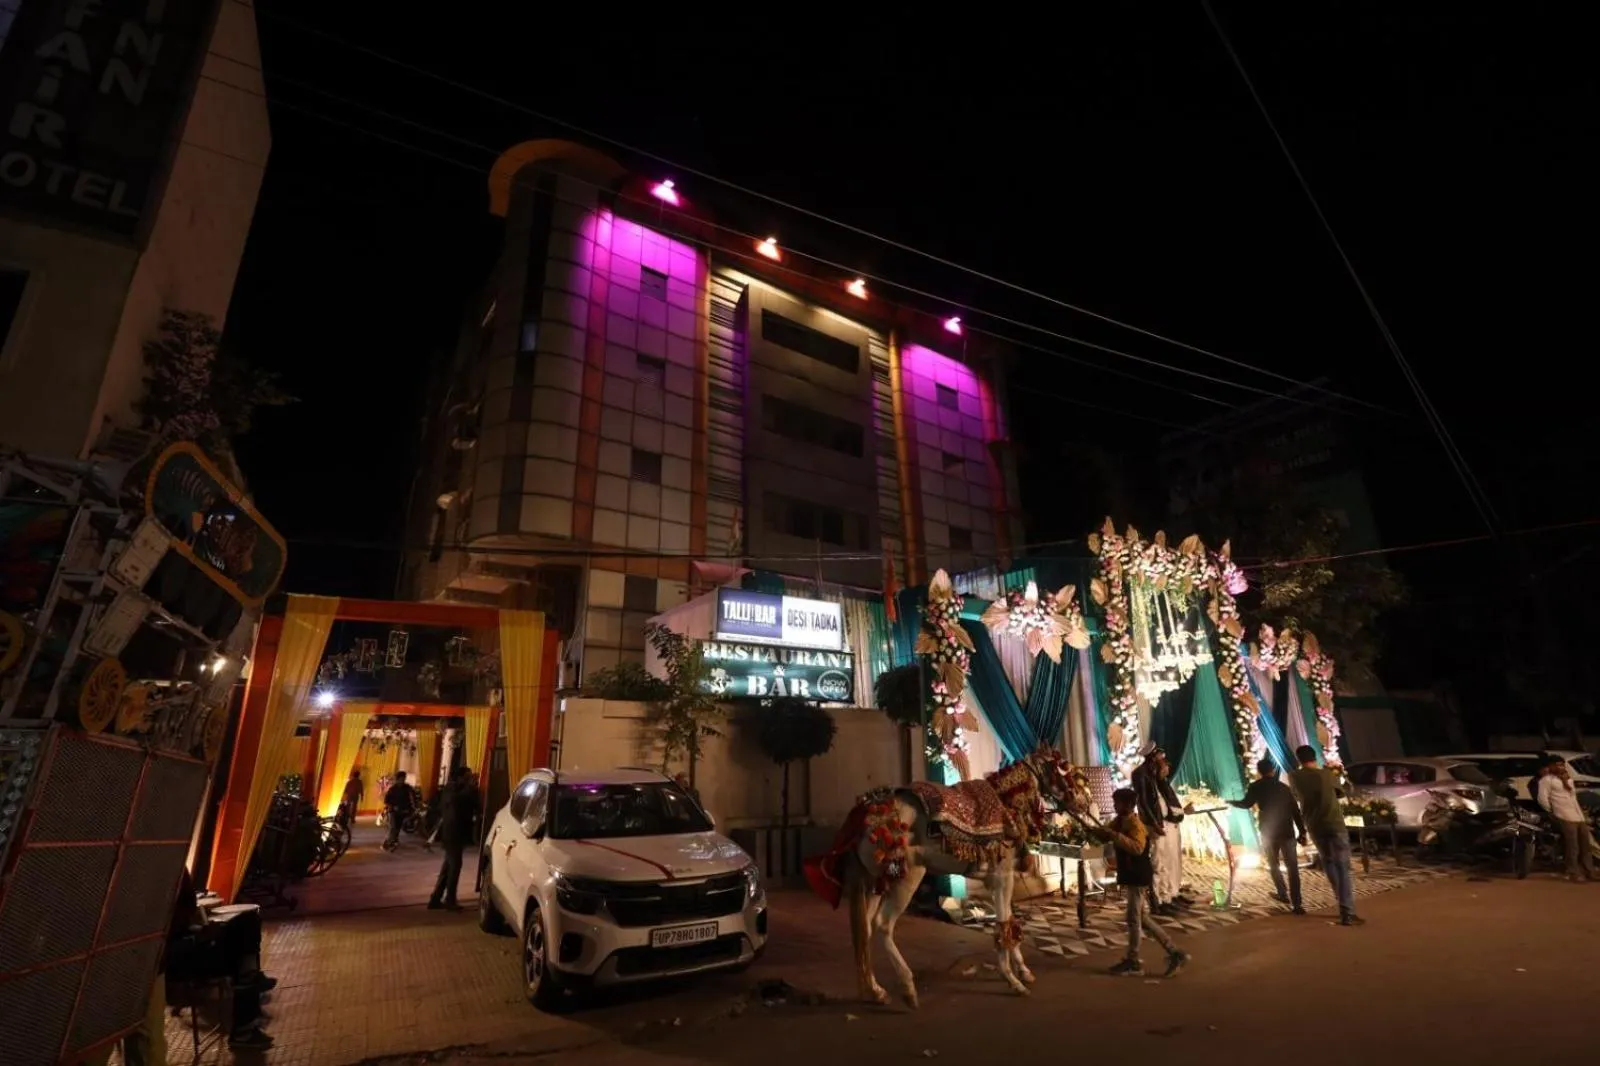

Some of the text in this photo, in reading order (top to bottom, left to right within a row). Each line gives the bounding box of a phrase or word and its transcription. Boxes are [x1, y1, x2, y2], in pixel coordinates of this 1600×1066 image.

[787, 608, 807, 628] DESI
[810, 611, 838, 632] TADKA
[702, 640, 852, 669] RESTAURANT
[772, 664, 786, 677] &
[746, 674, 812, 698] BAR
[822, 686, 847, 694] OPEN
[823, 678, 846, 687] NOW
